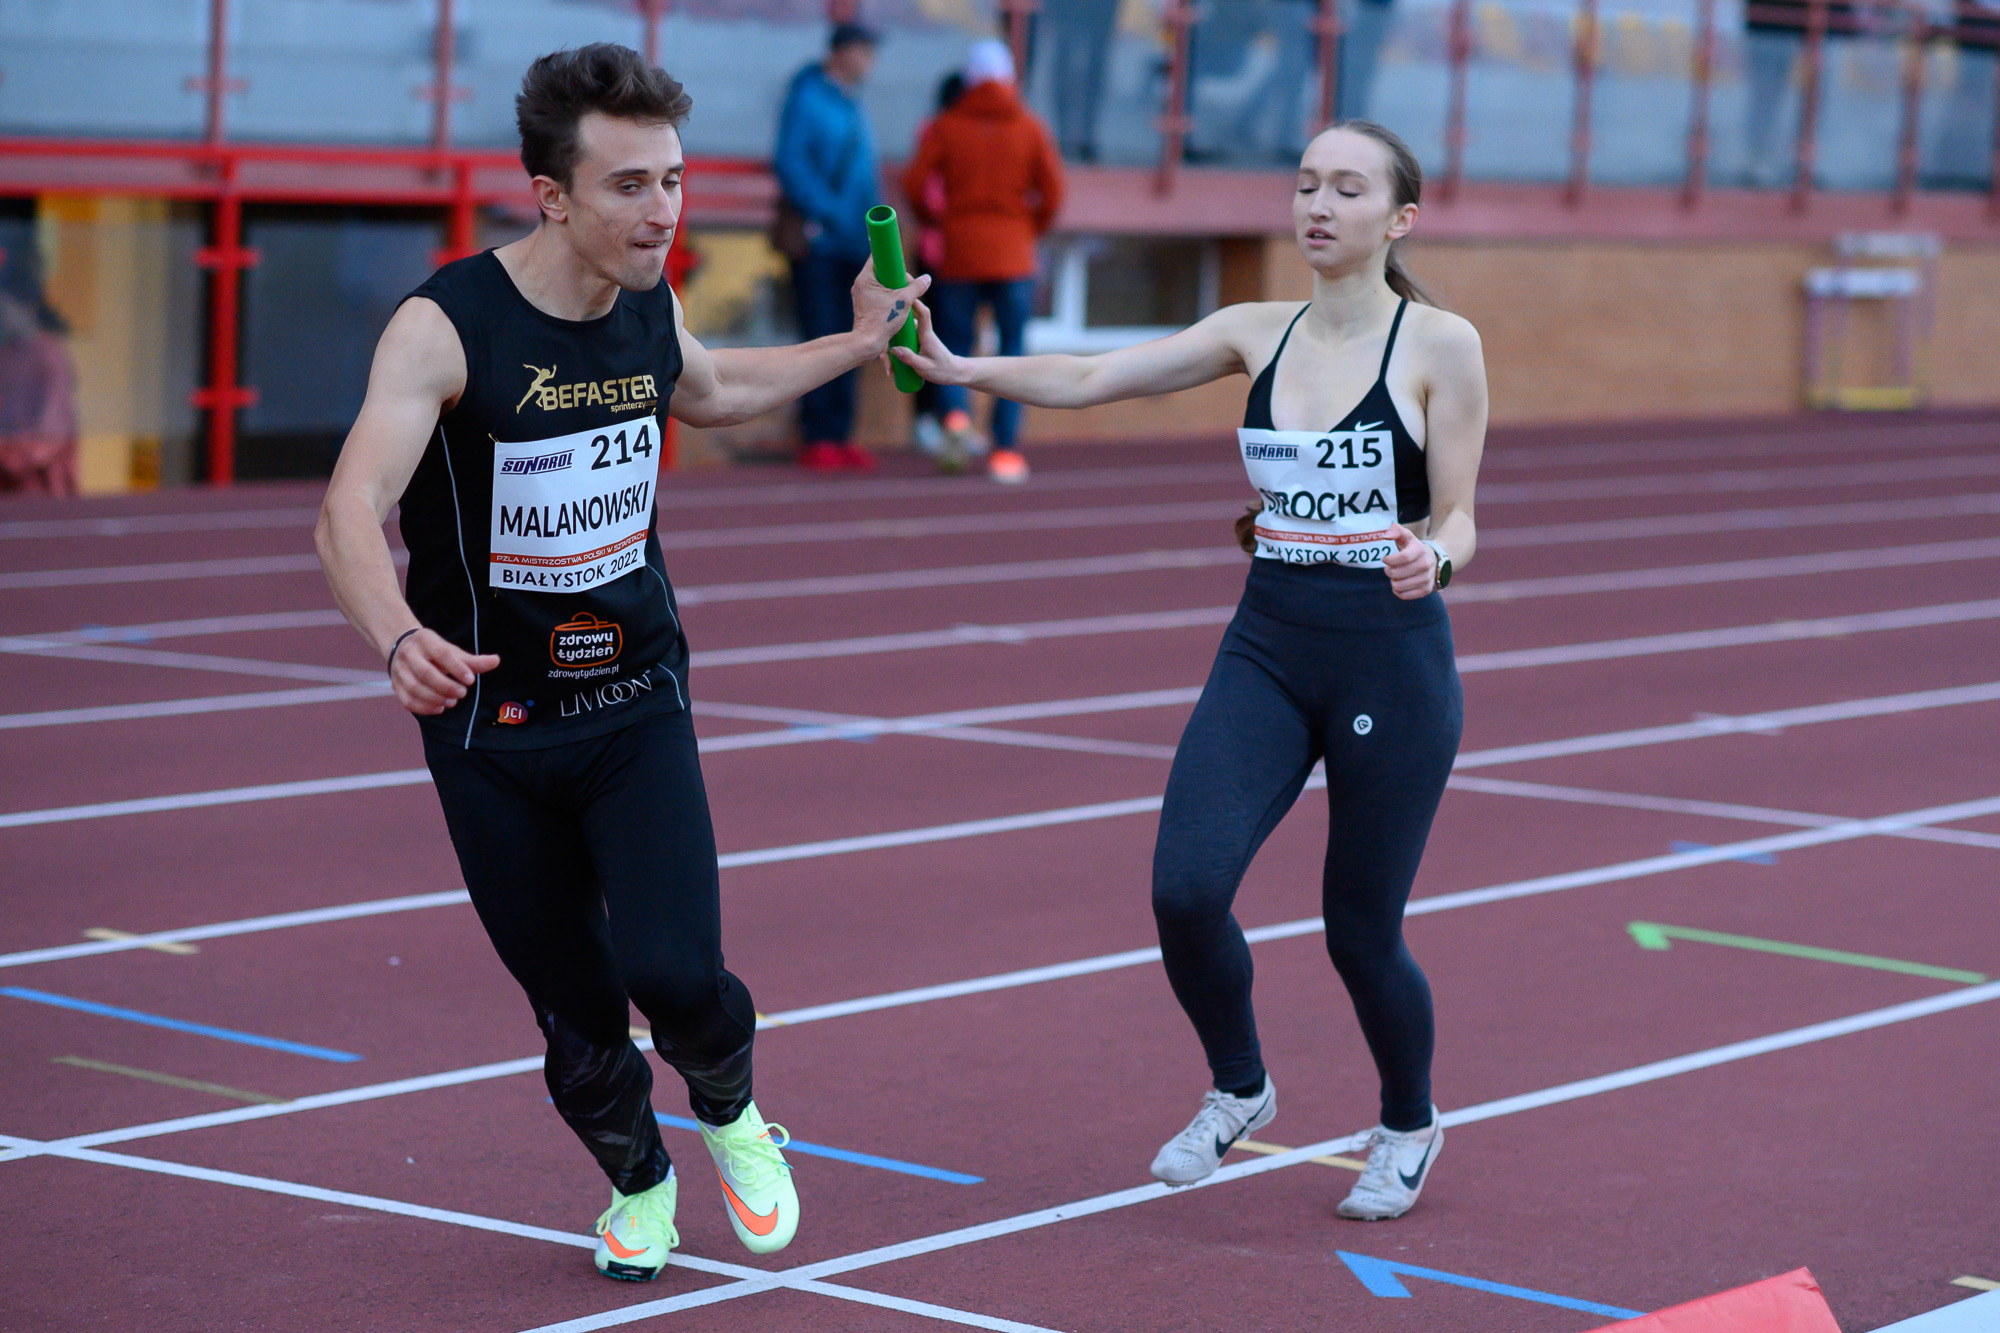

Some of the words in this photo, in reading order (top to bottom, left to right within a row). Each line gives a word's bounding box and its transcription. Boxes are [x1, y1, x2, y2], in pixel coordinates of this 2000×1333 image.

[542, 374, 659, 411] BEFASTER
[590, 424, 653, 471] 214
[1245, 443, 1299, 461] SONAROL
[1315, 437, 1383, 469] 215
[501, 452, 573, 475] SONAROL
[499, 480, 650, 538] MALANOWSKI
[496, 555, 520, 563] PZLA
[521, 556, 583, 566] MISTRZOSTWA
[583, 548, 606, 561] POLSKI
[1347, 545, 1392, 564] 2022
[502, 562, 606, 588] BIAŁYSTOK
[610, 548, 639, 576] 2022
[559, 631, 614, 646] zdrowy
[547, 664, 620, 680] zdrowytydzien.pl
[503, 705, 523, 720] JCI
